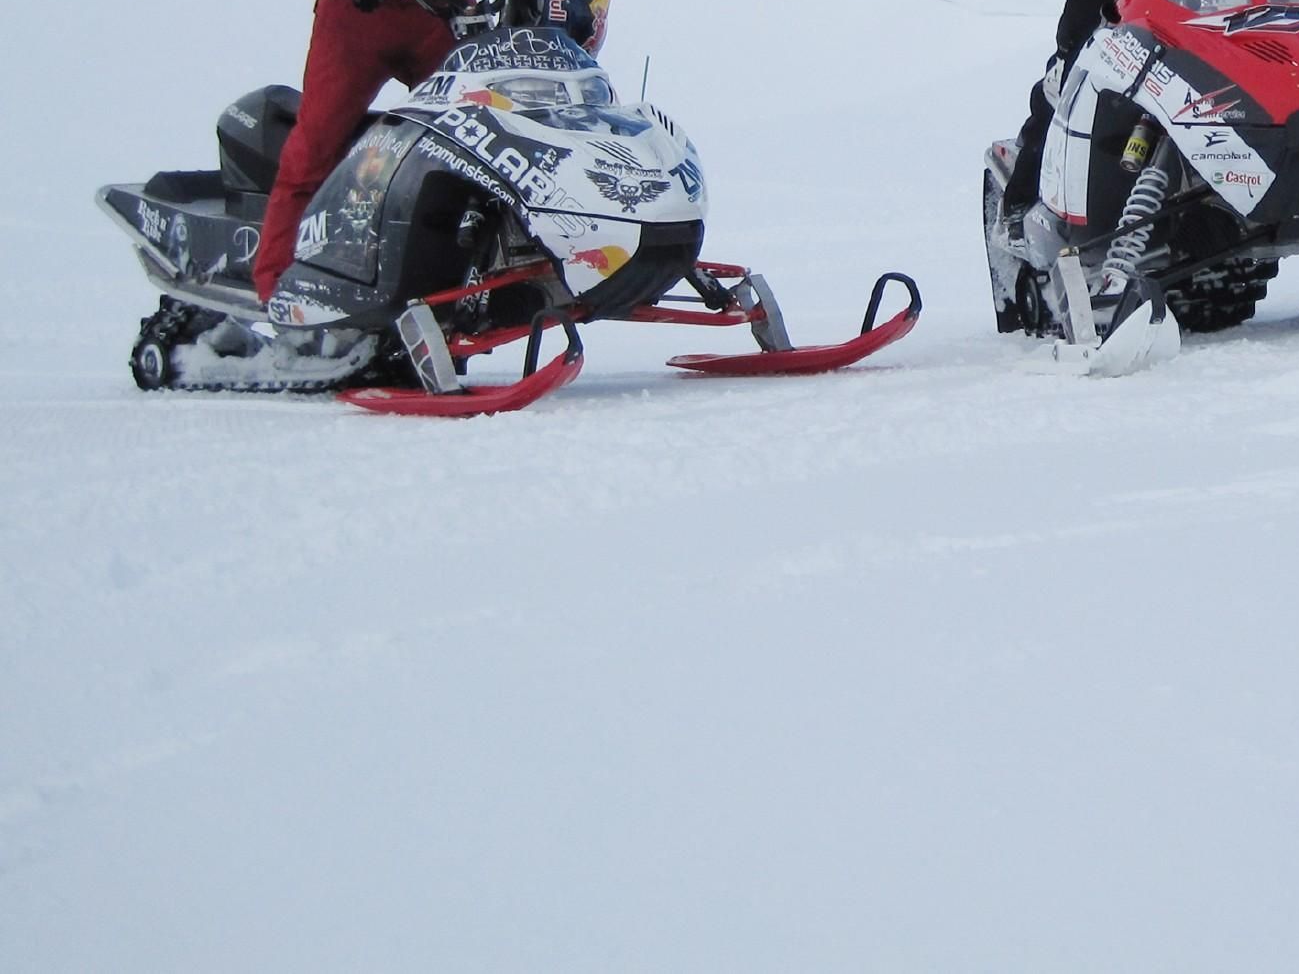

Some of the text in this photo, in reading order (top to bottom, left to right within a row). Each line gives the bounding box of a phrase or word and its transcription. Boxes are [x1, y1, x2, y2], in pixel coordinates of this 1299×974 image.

[444, 28, 517, 71] Daniel
[1121, 31, 1174, 85] POLAIS
[433, 108, 592, 238] POLARIS
[1191, 151, 1251, 161] camoplast
[1226, 171, 1262, 186] Castrol
